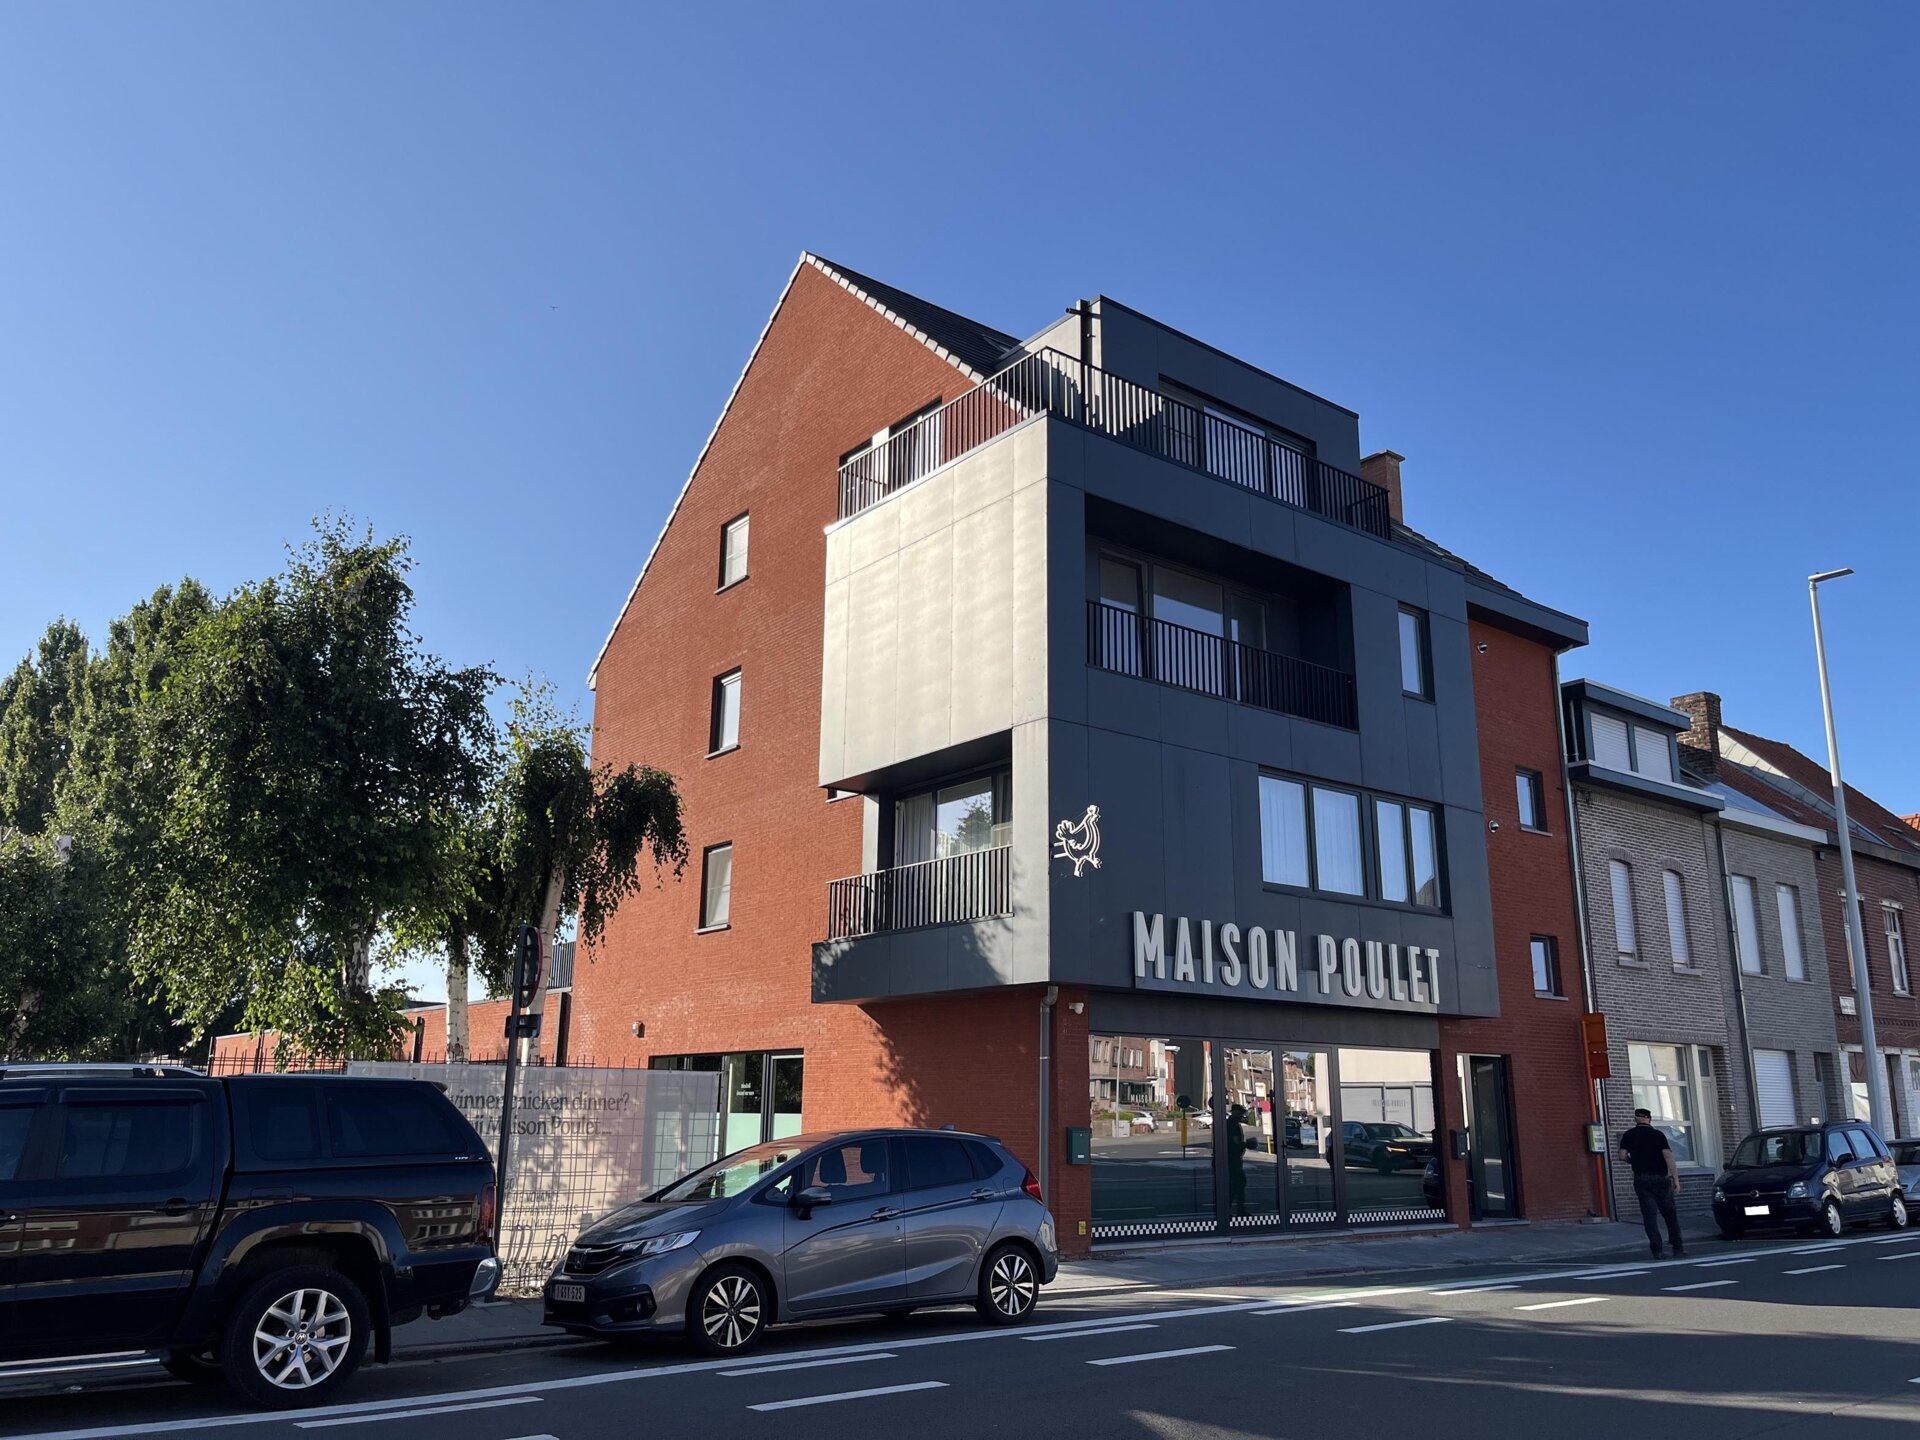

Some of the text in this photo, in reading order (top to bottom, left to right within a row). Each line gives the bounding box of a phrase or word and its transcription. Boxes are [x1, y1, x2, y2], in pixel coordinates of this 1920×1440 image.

[1133, 911, 1440, 1005] MAISON POULET
[572, 1092, 630, 1111] dinner?
[486, 1115, 546, 1136] Mison
